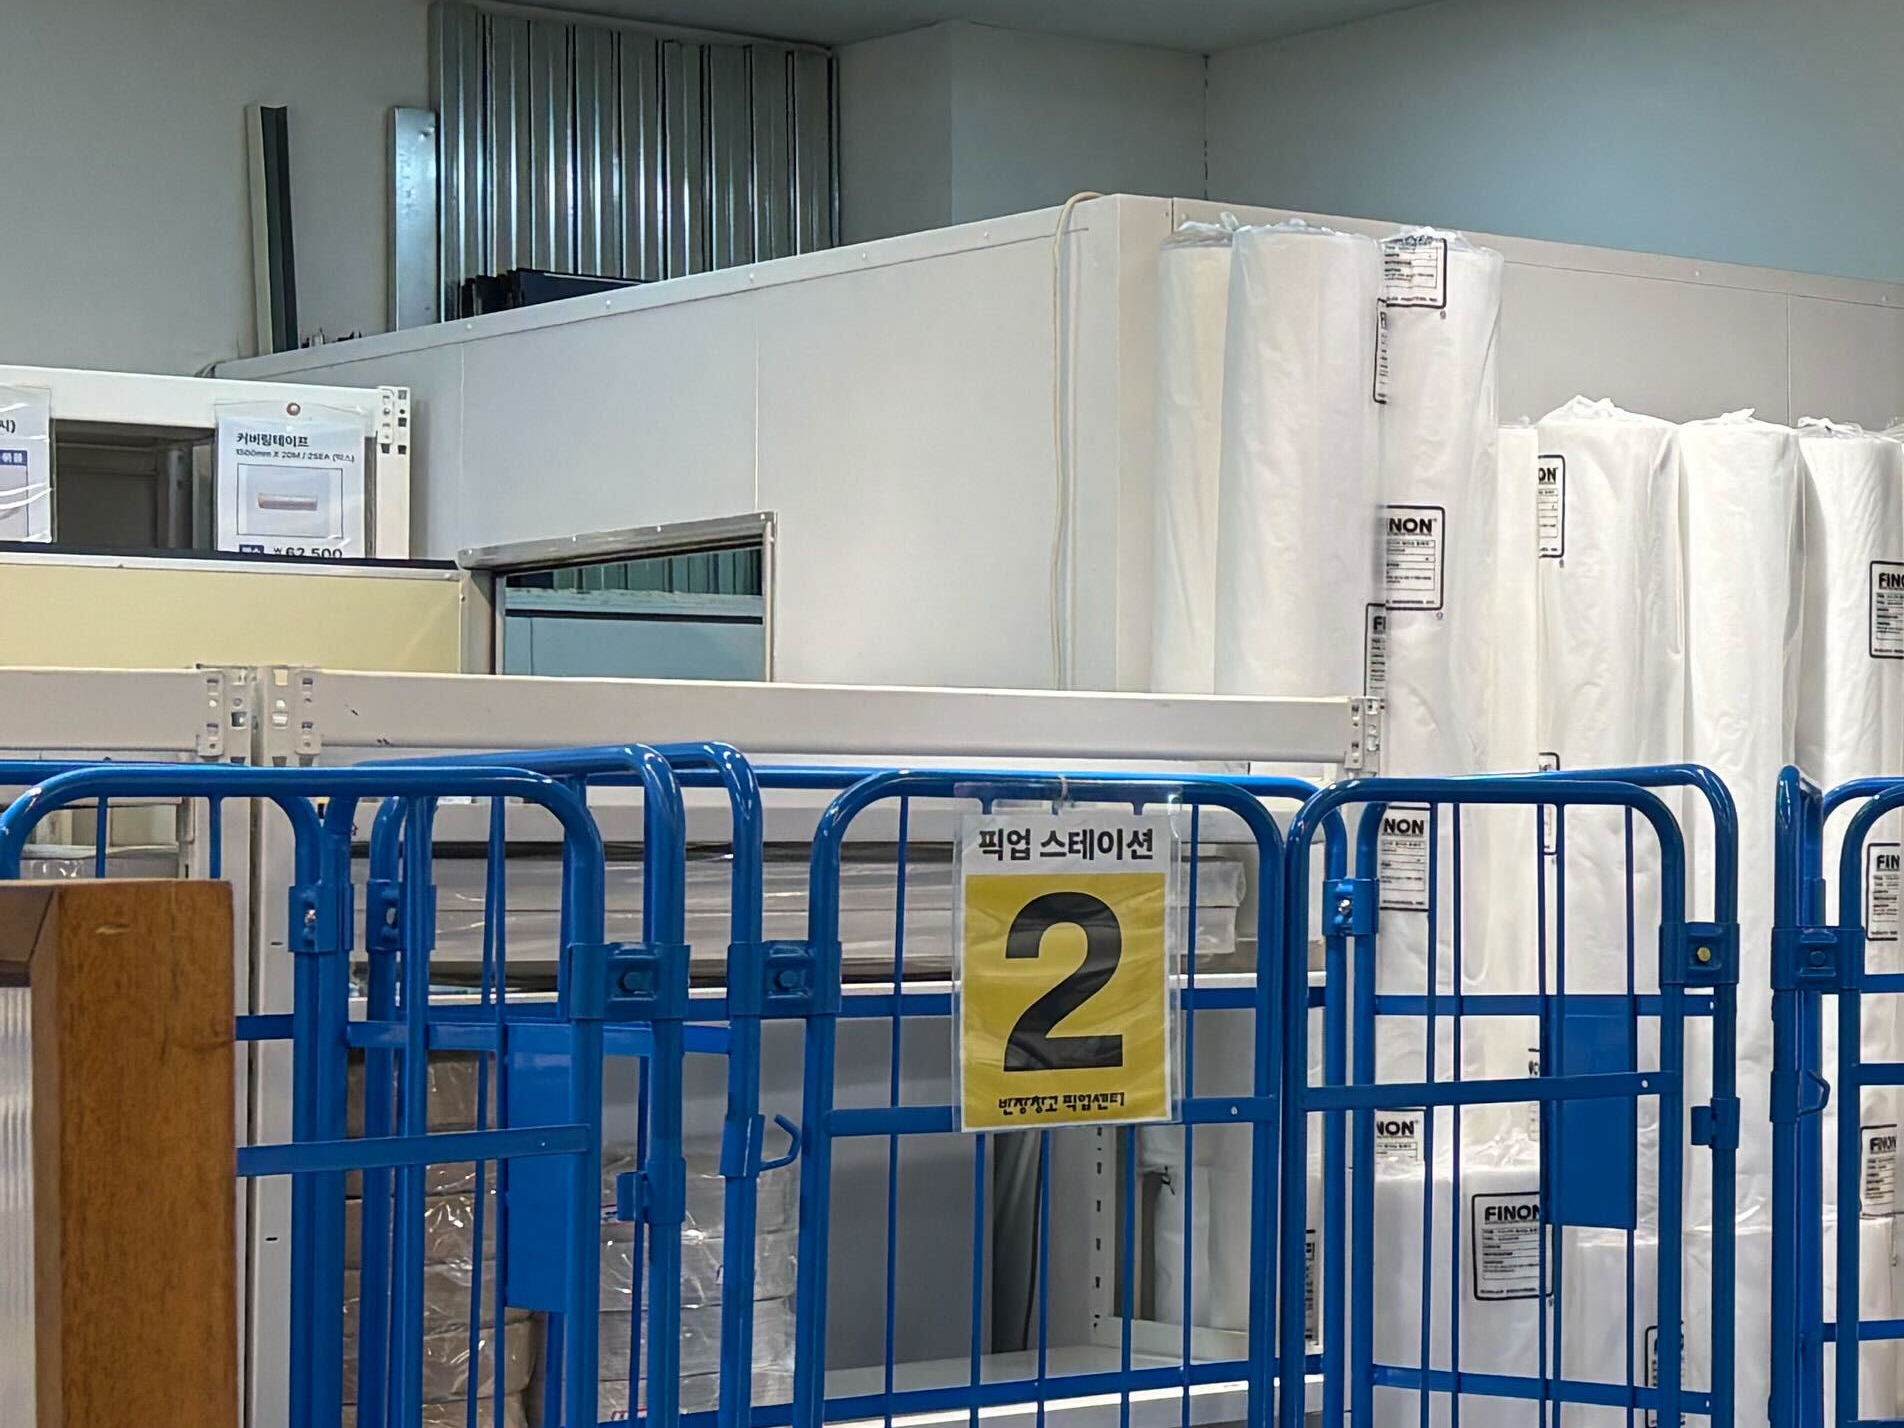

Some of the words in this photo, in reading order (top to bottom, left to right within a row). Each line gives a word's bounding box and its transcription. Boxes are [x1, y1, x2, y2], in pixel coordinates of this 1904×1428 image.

[236, 432, 310, 447] 커버링테이프
[1388, 517, 1432, 533] NON
[286, 547, 343, 558] 62500
[1879, 573, 1904, 589] FIN
[1384, 818, 1424, 834] NON
[978, 828, 1031, 861] 픽업
[1039, 828, 1154, 862] 스테이션
[1877, 854, 1900, 869] FIN
[1003, 891, 1123, 1072] 2
[1376, 1120, 1414, 1135] NON
